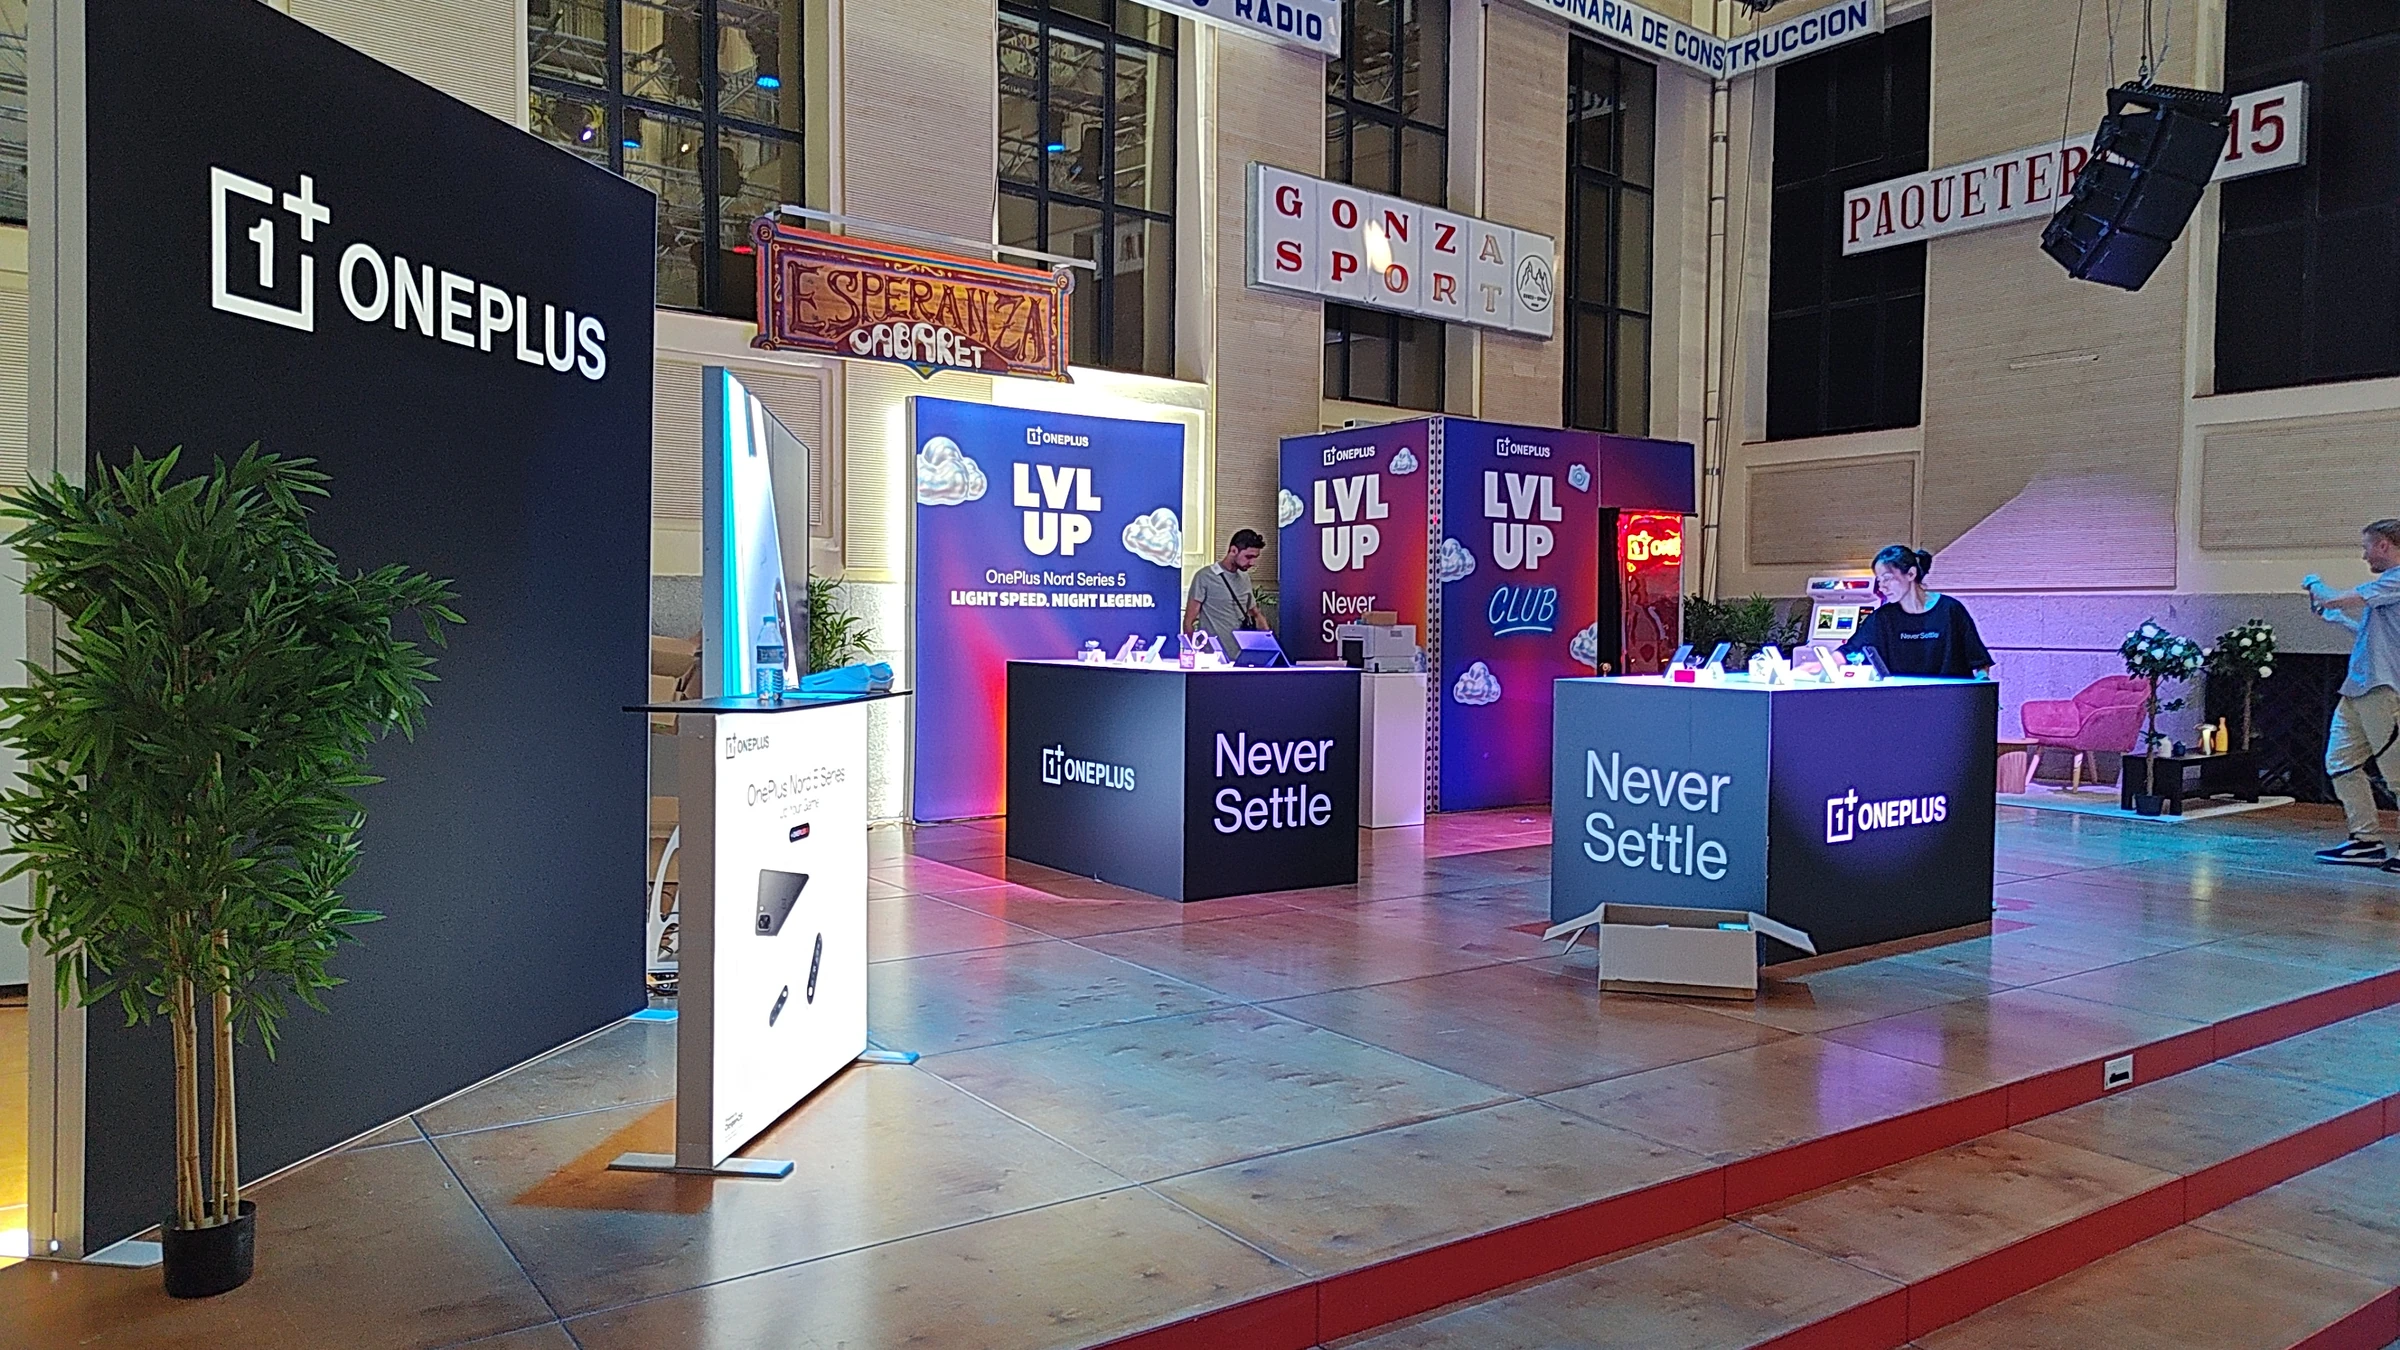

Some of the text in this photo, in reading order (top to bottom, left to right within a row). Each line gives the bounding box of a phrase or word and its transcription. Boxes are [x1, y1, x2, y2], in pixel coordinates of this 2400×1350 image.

[1235, 0, 1322, 42] RADIO
[1641, 16, 1668, 49] DE
[1848, 146, 2107, 243] PAQUETER
[1275, 186, 1504, 265] GONZA
[1276, 240, 1503, 313] SPORT
[339, 243, 607, 380] ONEPLUS
[788, 259, 1046, 363] ESPERANZA
[849, 322, 987, 369] CABARET
[1043, 432, 1089, 447] ONEPLUS
[1336, 446, 1376, 462] ONEPLUS
[1510, 443, 1551, 457] ONEPLUS
[1013, 462, 1102, 511] LVL
[1314, 473, 1389, 524] LVL
[1484, 471, 1562, 521] LVL
[1023, 510, 1092, 556] UP
[1322, 524, 1380, 572] UP
[1493, 522, 1554, 570] UP
[950, 590, 1155, 608] LIGHT SPEED. NIGHT LEGEND.
[986, 569, 1126, 587] OnePlus Nord Series 5
[1322, 591, 1376, 614] Never
[1488, 586, 1557, 625] CLUB
[737, 735, 770, 754] ONEPLUS
[1216, 732, 1334, 777] Never
[747, 779, 788, 807] OnePlus
[1064, 758, 1135, 791] ONEPLUS
[1586, 749, 1732, 814] Never
[1214, 784, 1332, 834] Settle
[1857, 794, 1947, 831] ONEPLUS
[1583, 812, 1729, 881] Settle
